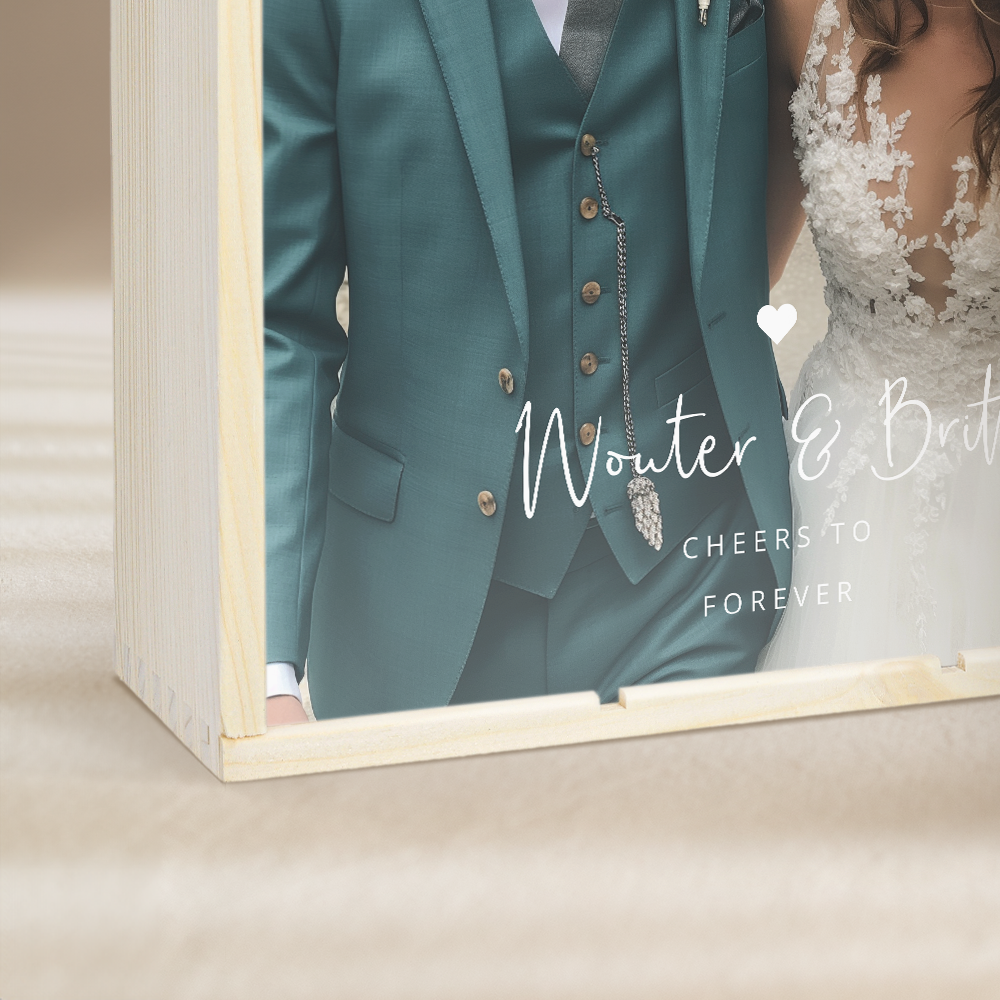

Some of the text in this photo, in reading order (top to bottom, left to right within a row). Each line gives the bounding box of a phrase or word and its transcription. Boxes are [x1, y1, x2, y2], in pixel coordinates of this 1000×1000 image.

[515, 393, 757, 519] Wouter
[791, 392, 841, 481] &
[682, 520, 871, 560] CHEERS TO
[703, 581, 853, 617] FOREVER
